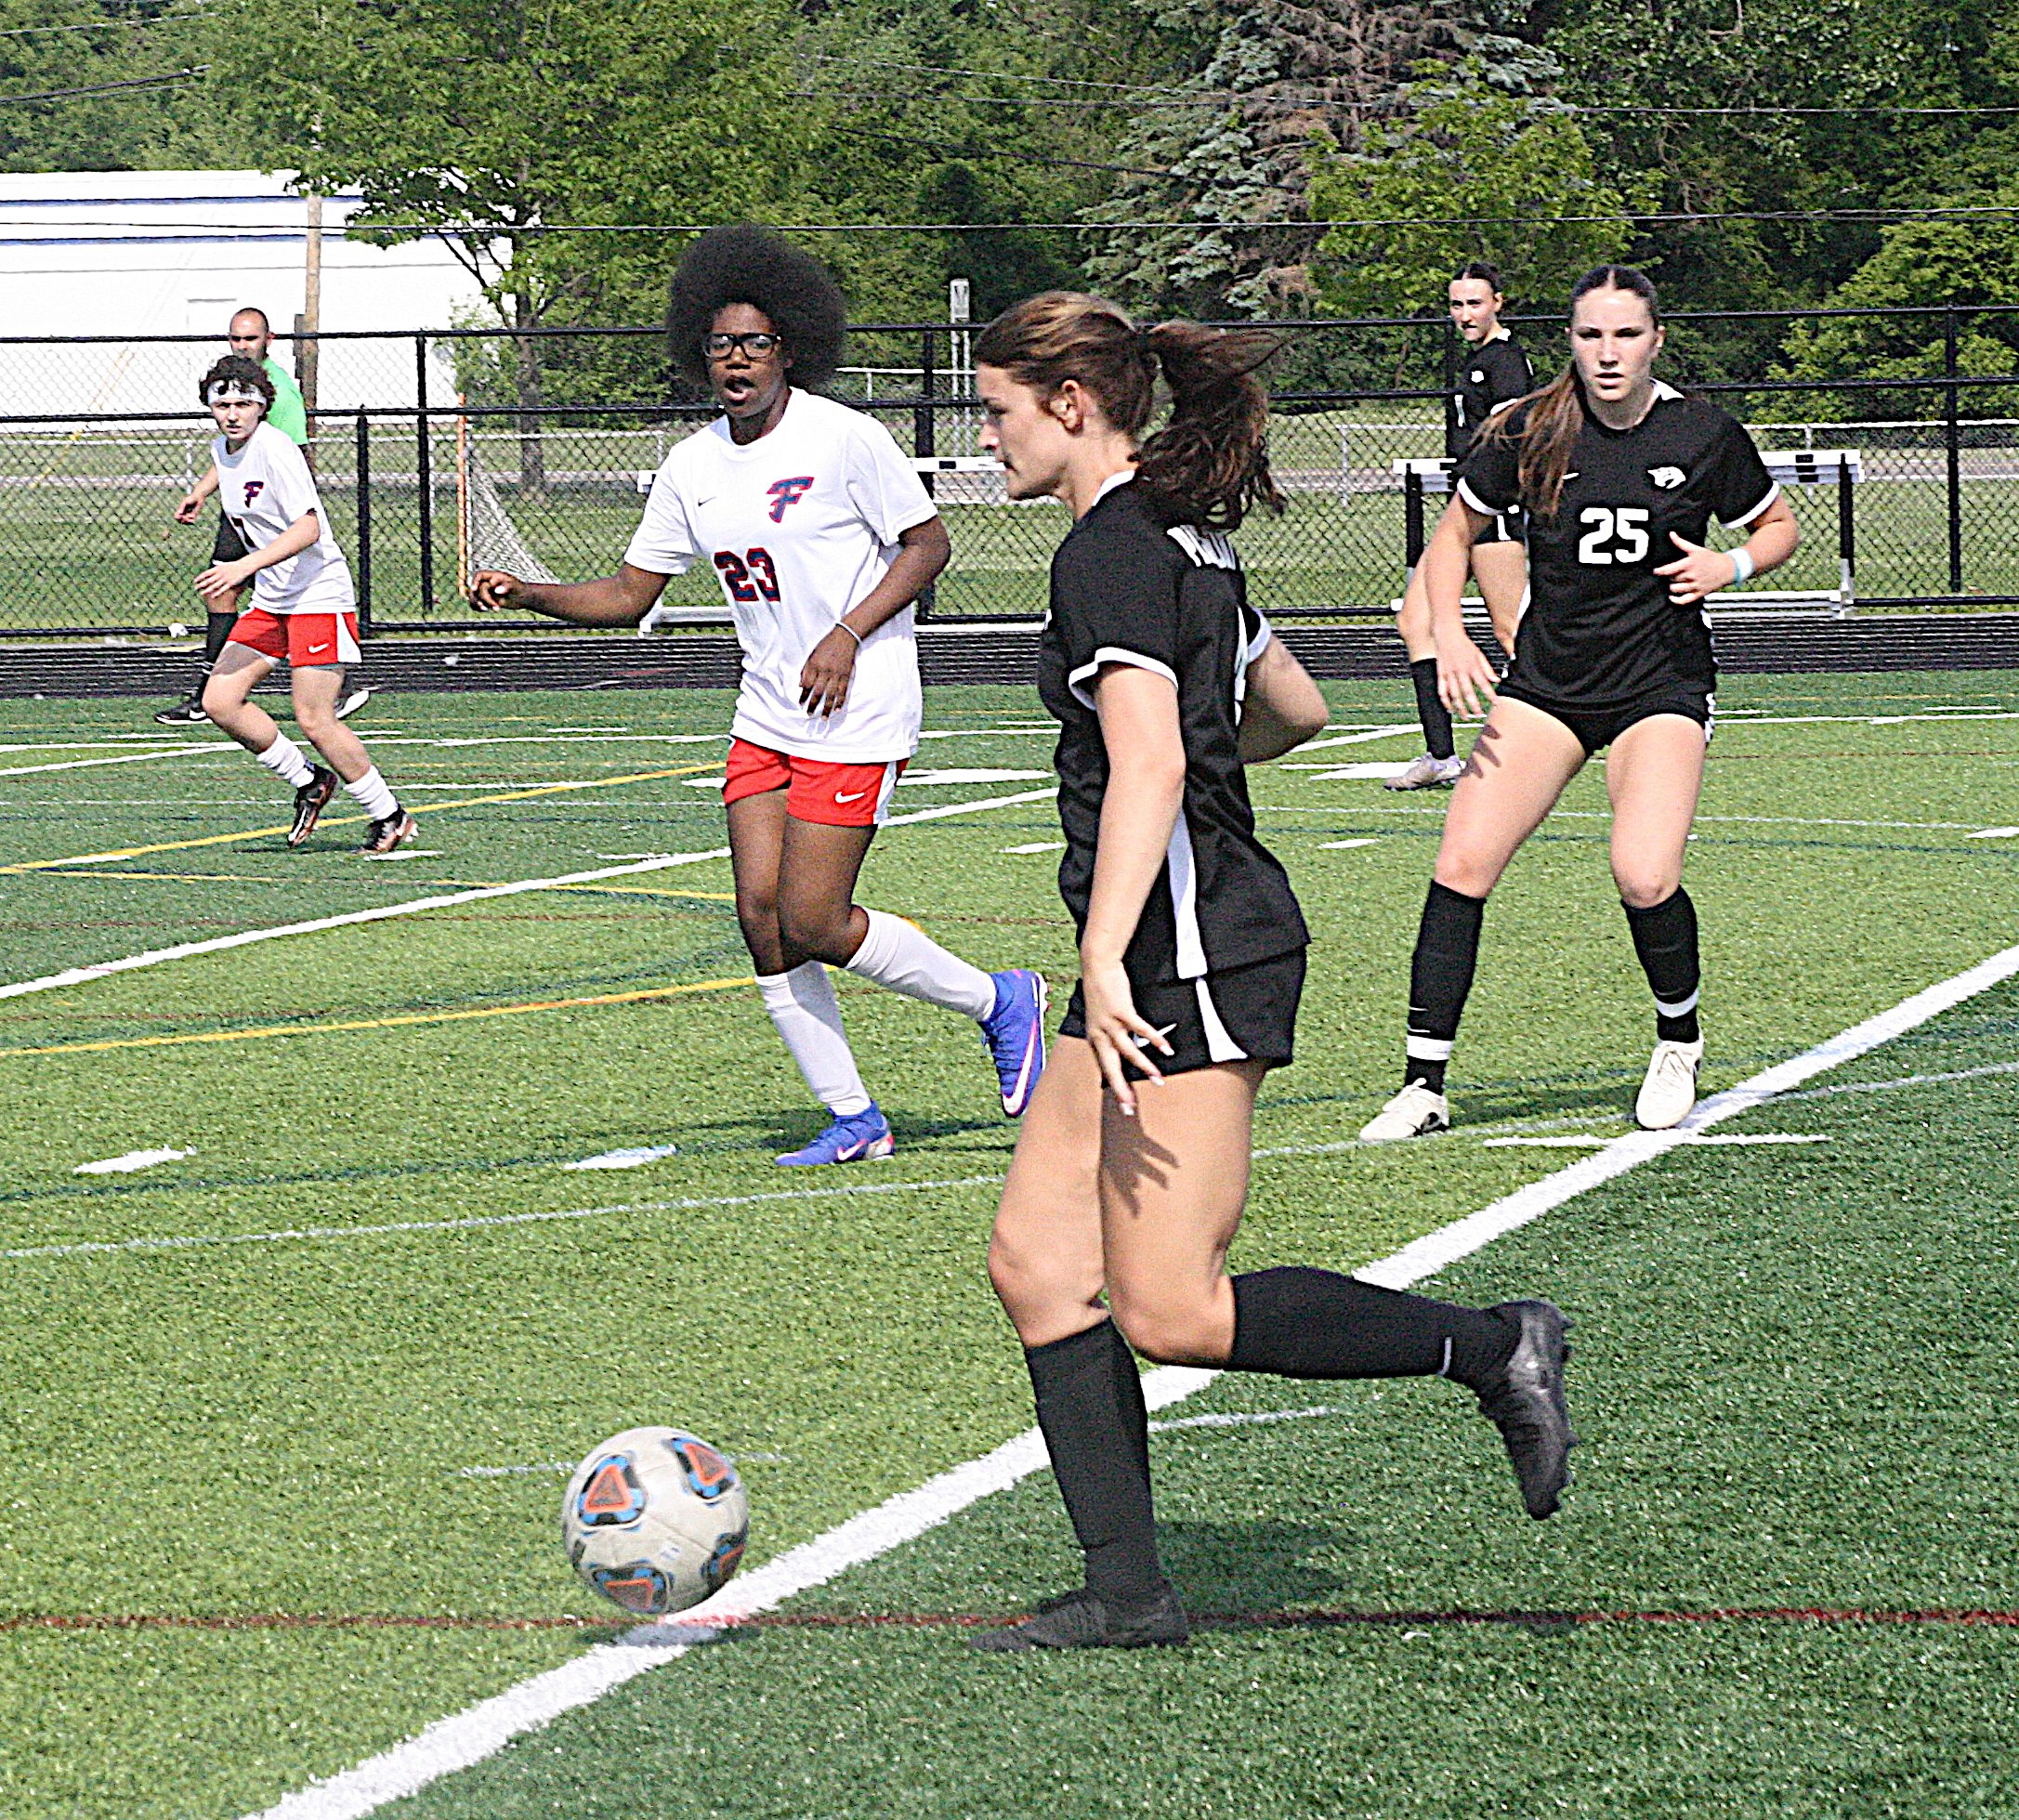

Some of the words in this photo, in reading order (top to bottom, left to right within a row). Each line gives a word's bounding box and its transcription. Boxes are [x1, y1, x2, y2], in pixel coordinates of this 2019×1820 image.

[243, 480, 265, 509] F
[766, 476, 815, 524] F
[1579, 507, 1649, 564] 25
[714, 547, 780, 602] 23
